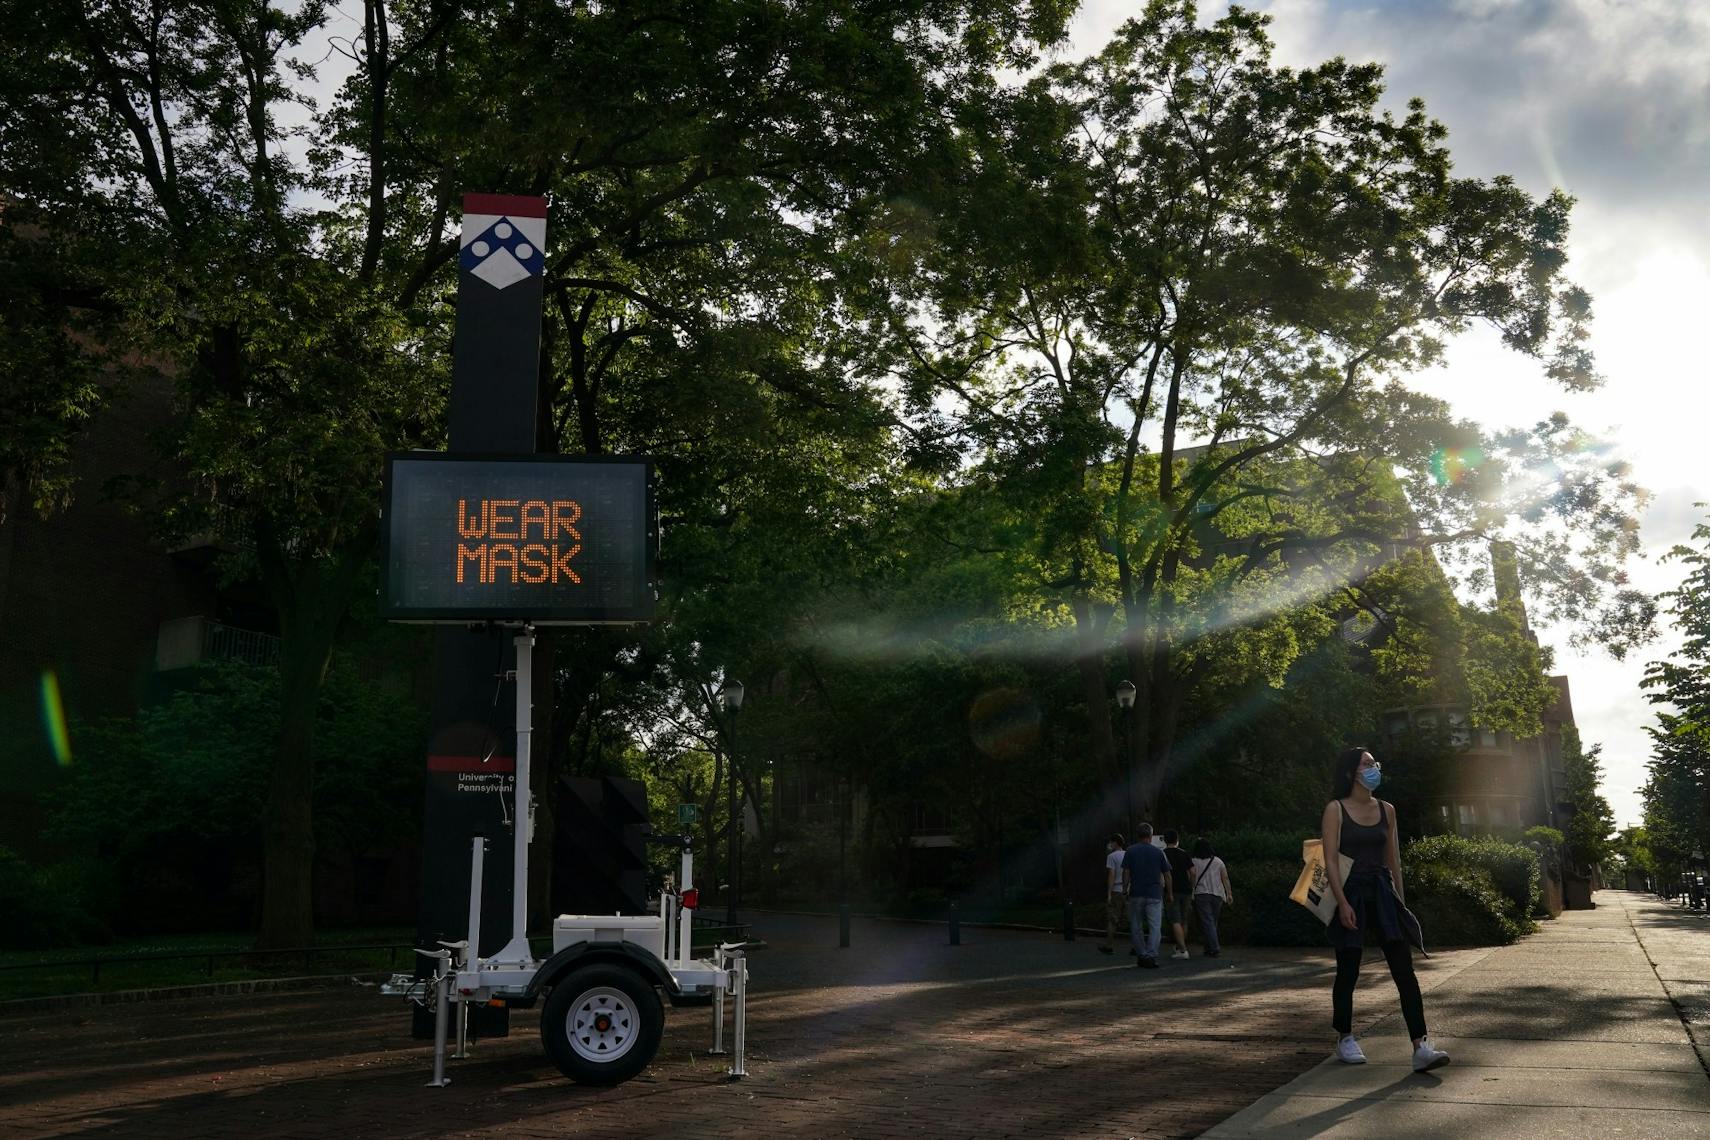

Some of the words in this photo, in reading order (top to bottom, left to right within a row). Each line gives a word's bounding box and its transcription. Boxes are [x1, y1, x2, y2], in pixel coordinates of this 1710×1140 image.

[458, 499, 581, 540] WEAR
[456, 543, 582, 583] MASK
[457, 784, 513, 793] Pennsylvani
